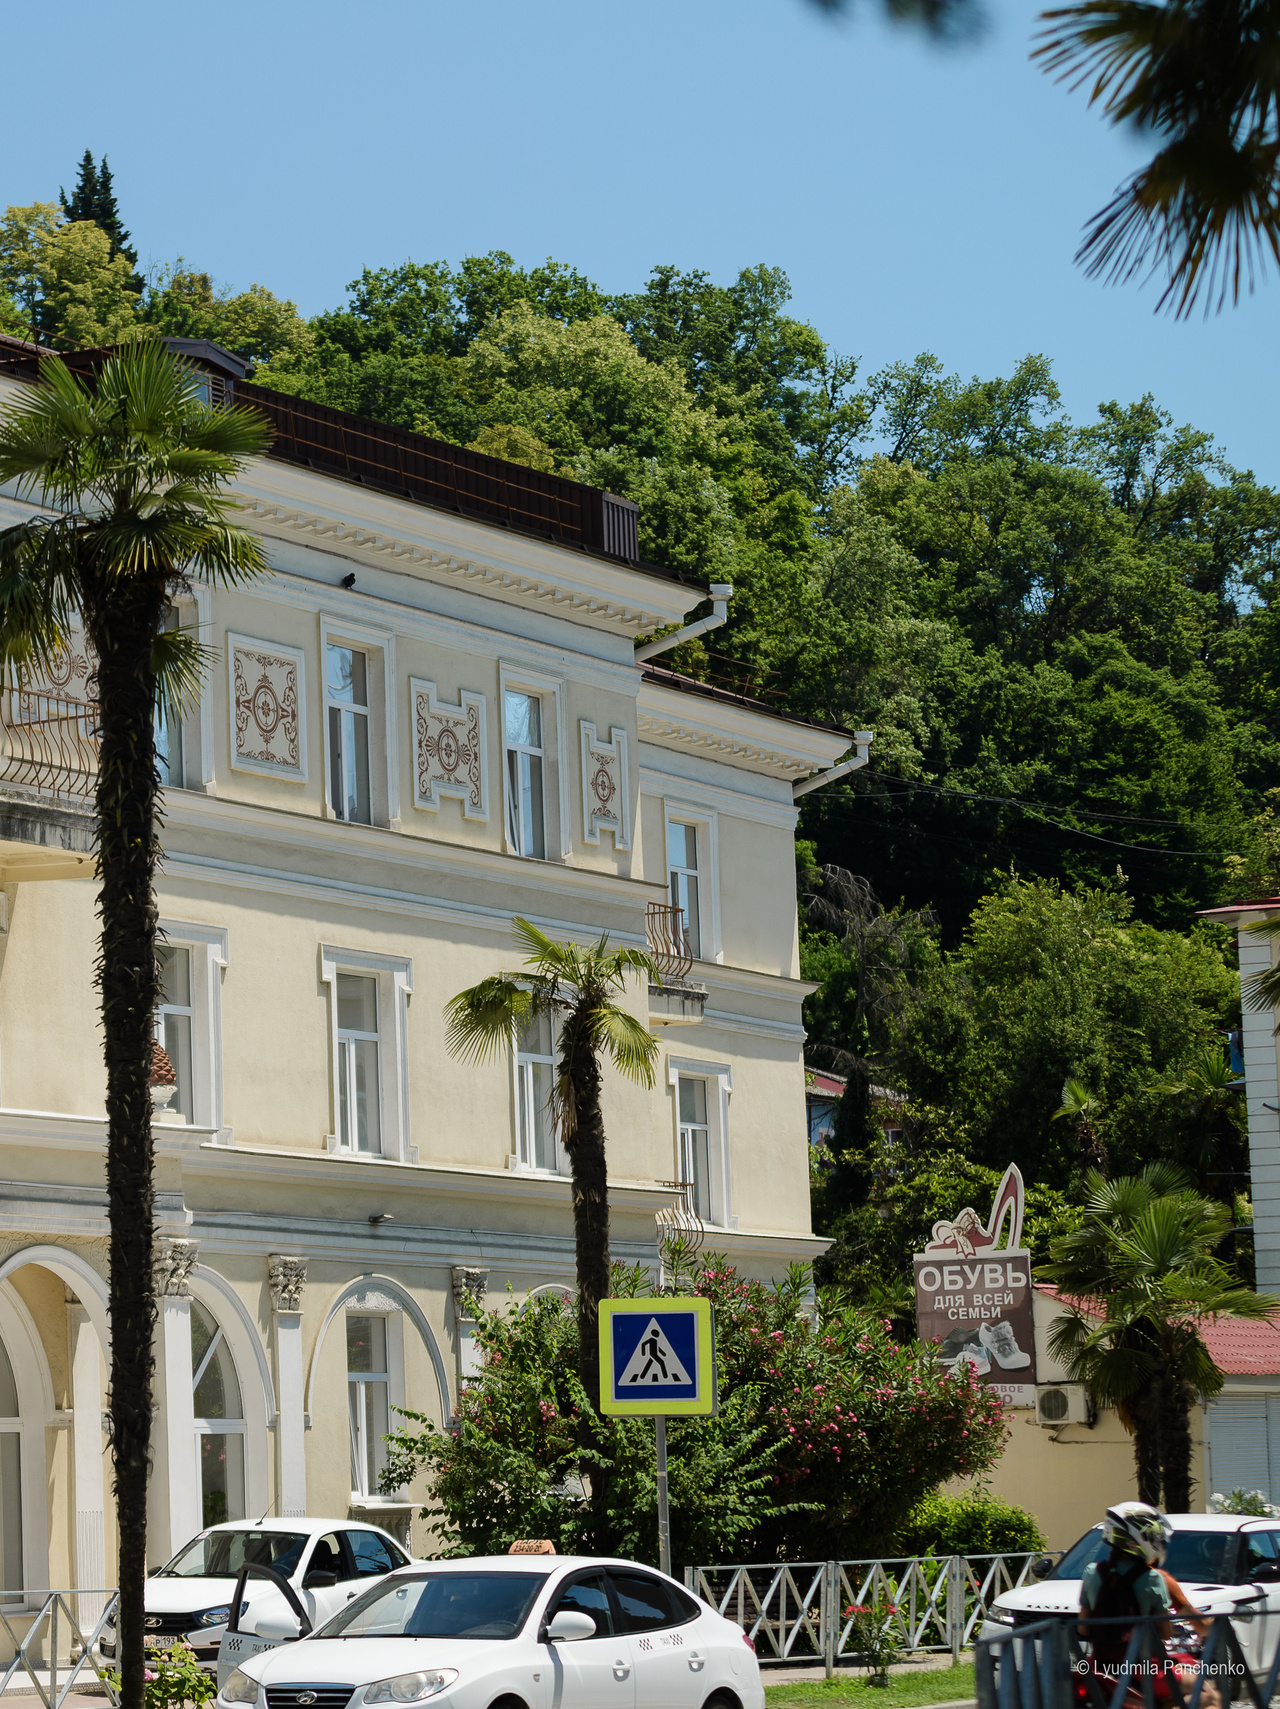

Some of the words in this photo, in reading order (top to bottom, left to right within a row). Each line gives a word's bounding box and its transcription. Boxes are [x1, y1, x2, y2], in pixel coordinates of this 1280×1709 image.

[918, 1263, 1027, 1292] ОБУВЬ
[933, 1295, 964, 1310] ДЛЯ
[973, 1290, 1014, 1306] ВСЕЙ
[947, 1306, 1001, 1321] СЕМЬИ
[162, 1637, 175, 1646] 193
